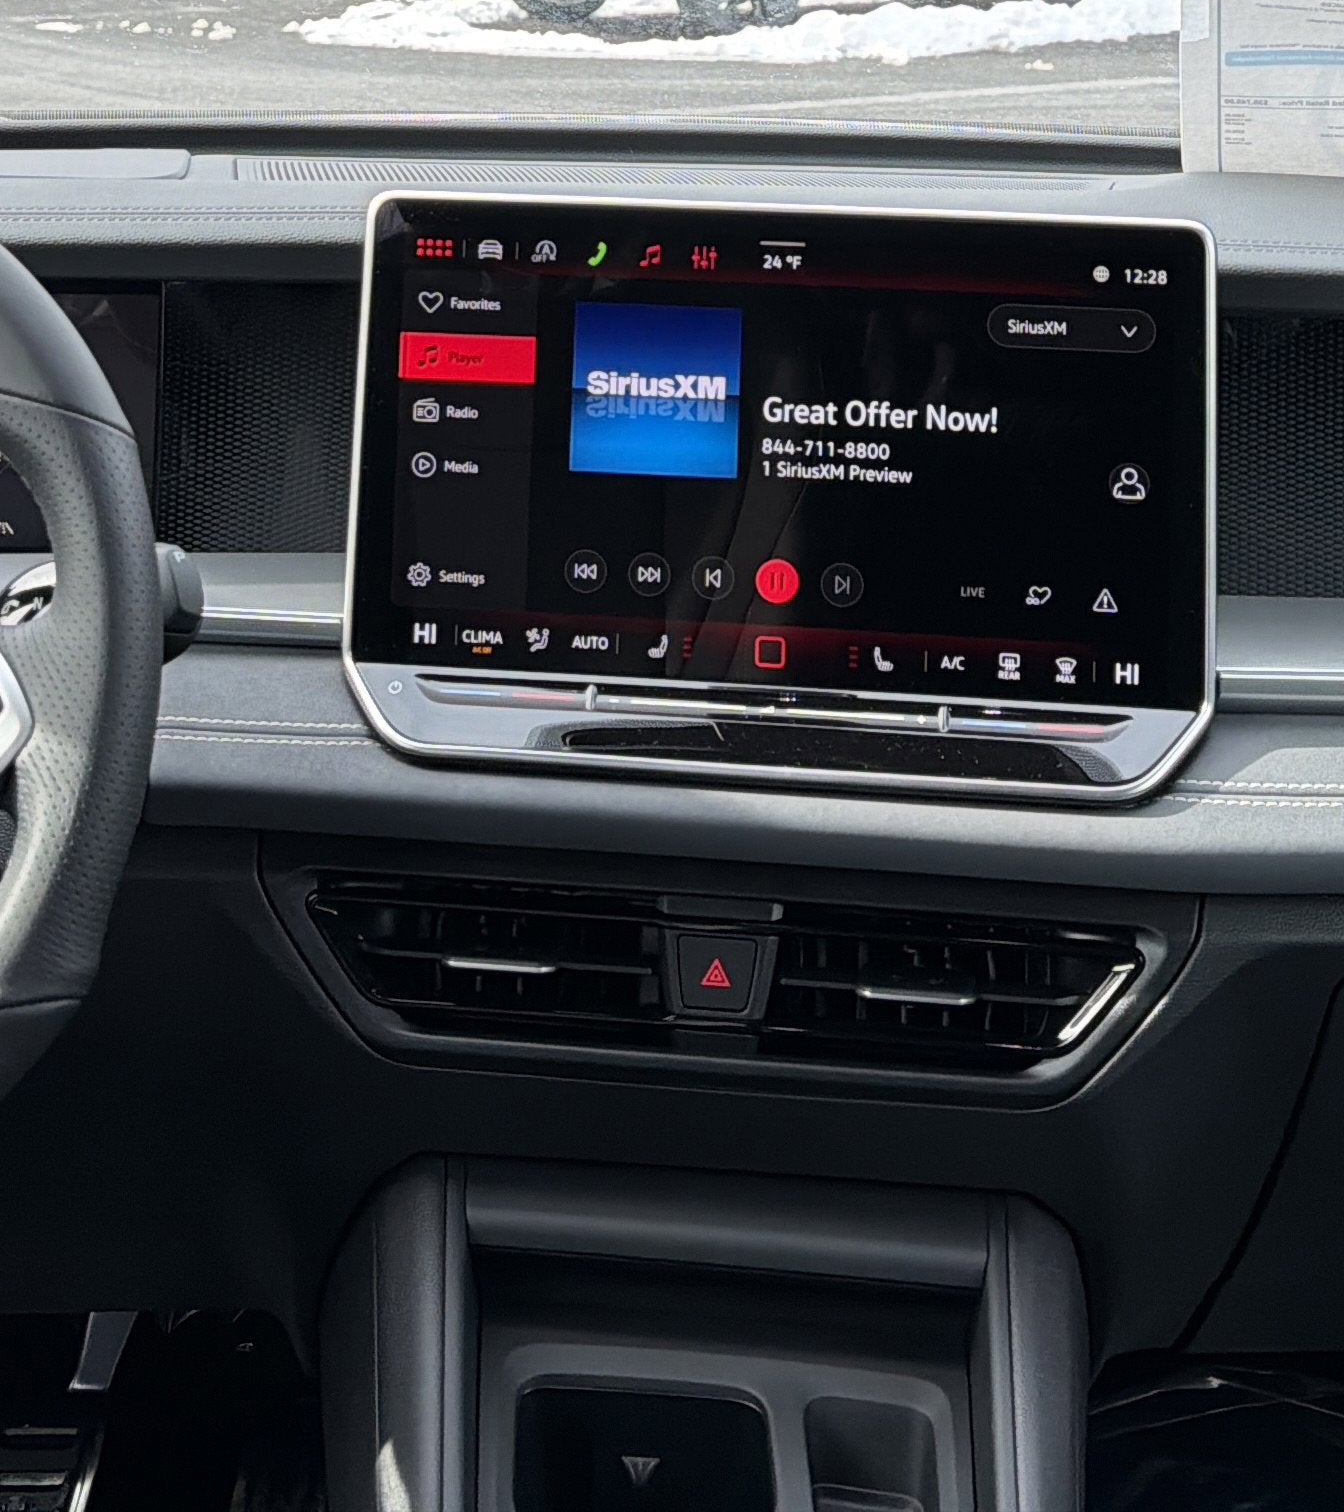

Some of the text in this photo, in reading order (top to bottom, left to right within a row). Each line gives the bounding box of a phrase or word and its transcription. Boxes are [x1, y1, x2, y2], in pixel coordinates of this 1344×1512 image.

[763, 255, 803, 270] 24 °F
[1125, 268, 1168, 285] 12:28
[450, 296, 501, 312] Favorites
[1007, 319, 1067, 336] SiriusXM
[447, 352, 484, 367] Player
[586, 370, 726, 400] SiriusXM
[446, 405, 479, 419] Radio
[762, 396, 999, 433] Great Offer Now!
[761, 438, 891, 461] 844-711-8800
[444, 460, 479, 474] Media
[762, 461, 913, 485] 1 SiriusXM Preview
[438, 570, 486, 585] Settings
[960, 586, 986, 599] LIVE
[33, 597, 45, 611] N
[413, 622, 437, 645] HI
[462, 629, 503, 645] CLIMA
[571, 635, 609, 651] AUTO
[940, 655, 966, 671] A/C
[998, 670, 1021, 680] REAR
[1055, 674, 1076, 684] MAX
[1114, 662, 1140, 686] HI
